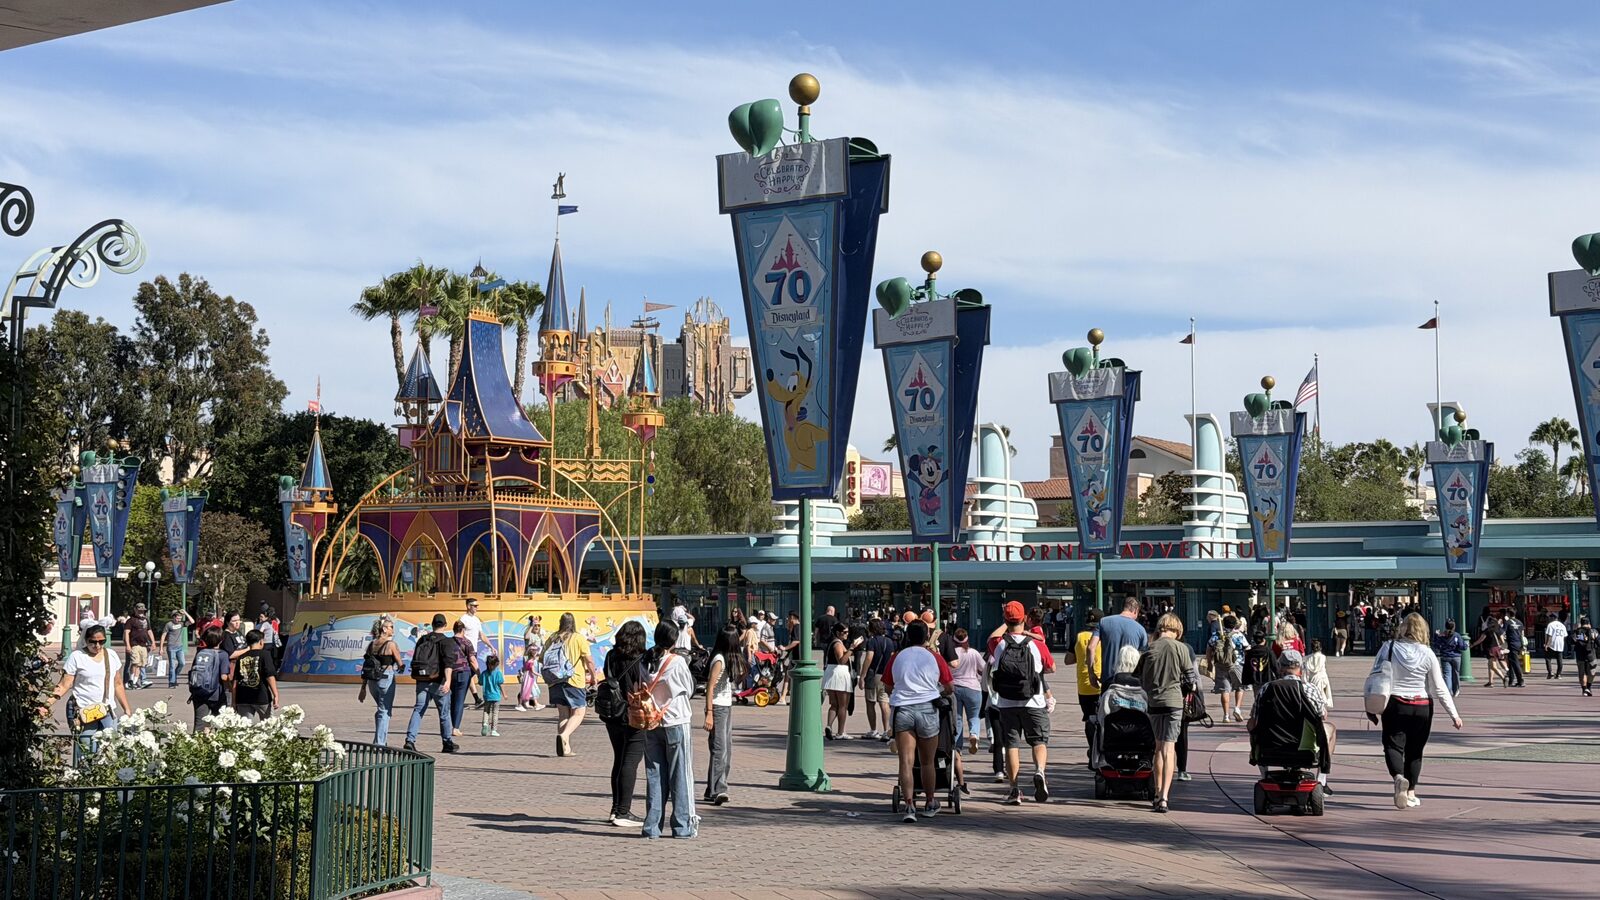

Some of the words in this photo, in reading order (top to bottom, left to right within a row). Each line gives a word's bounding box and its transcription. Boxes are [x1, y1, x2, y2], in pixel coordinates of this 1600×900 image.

[765, 270, 811, 305] 70
[771, 309, 811, 324] Disneyland
[905, 387, 934, 411] 70
[1077, 435, 1104, 453] 70
[1254, 464, 1277, 479] 70
[1447, 488, 1468, 500] 70
[94, 504, 109, 515] 70
[170, 528, 181, 537] 70
[1120, 541, 1255, 560] ADVENTU
[321, 636, 363, 651] Disneyland
